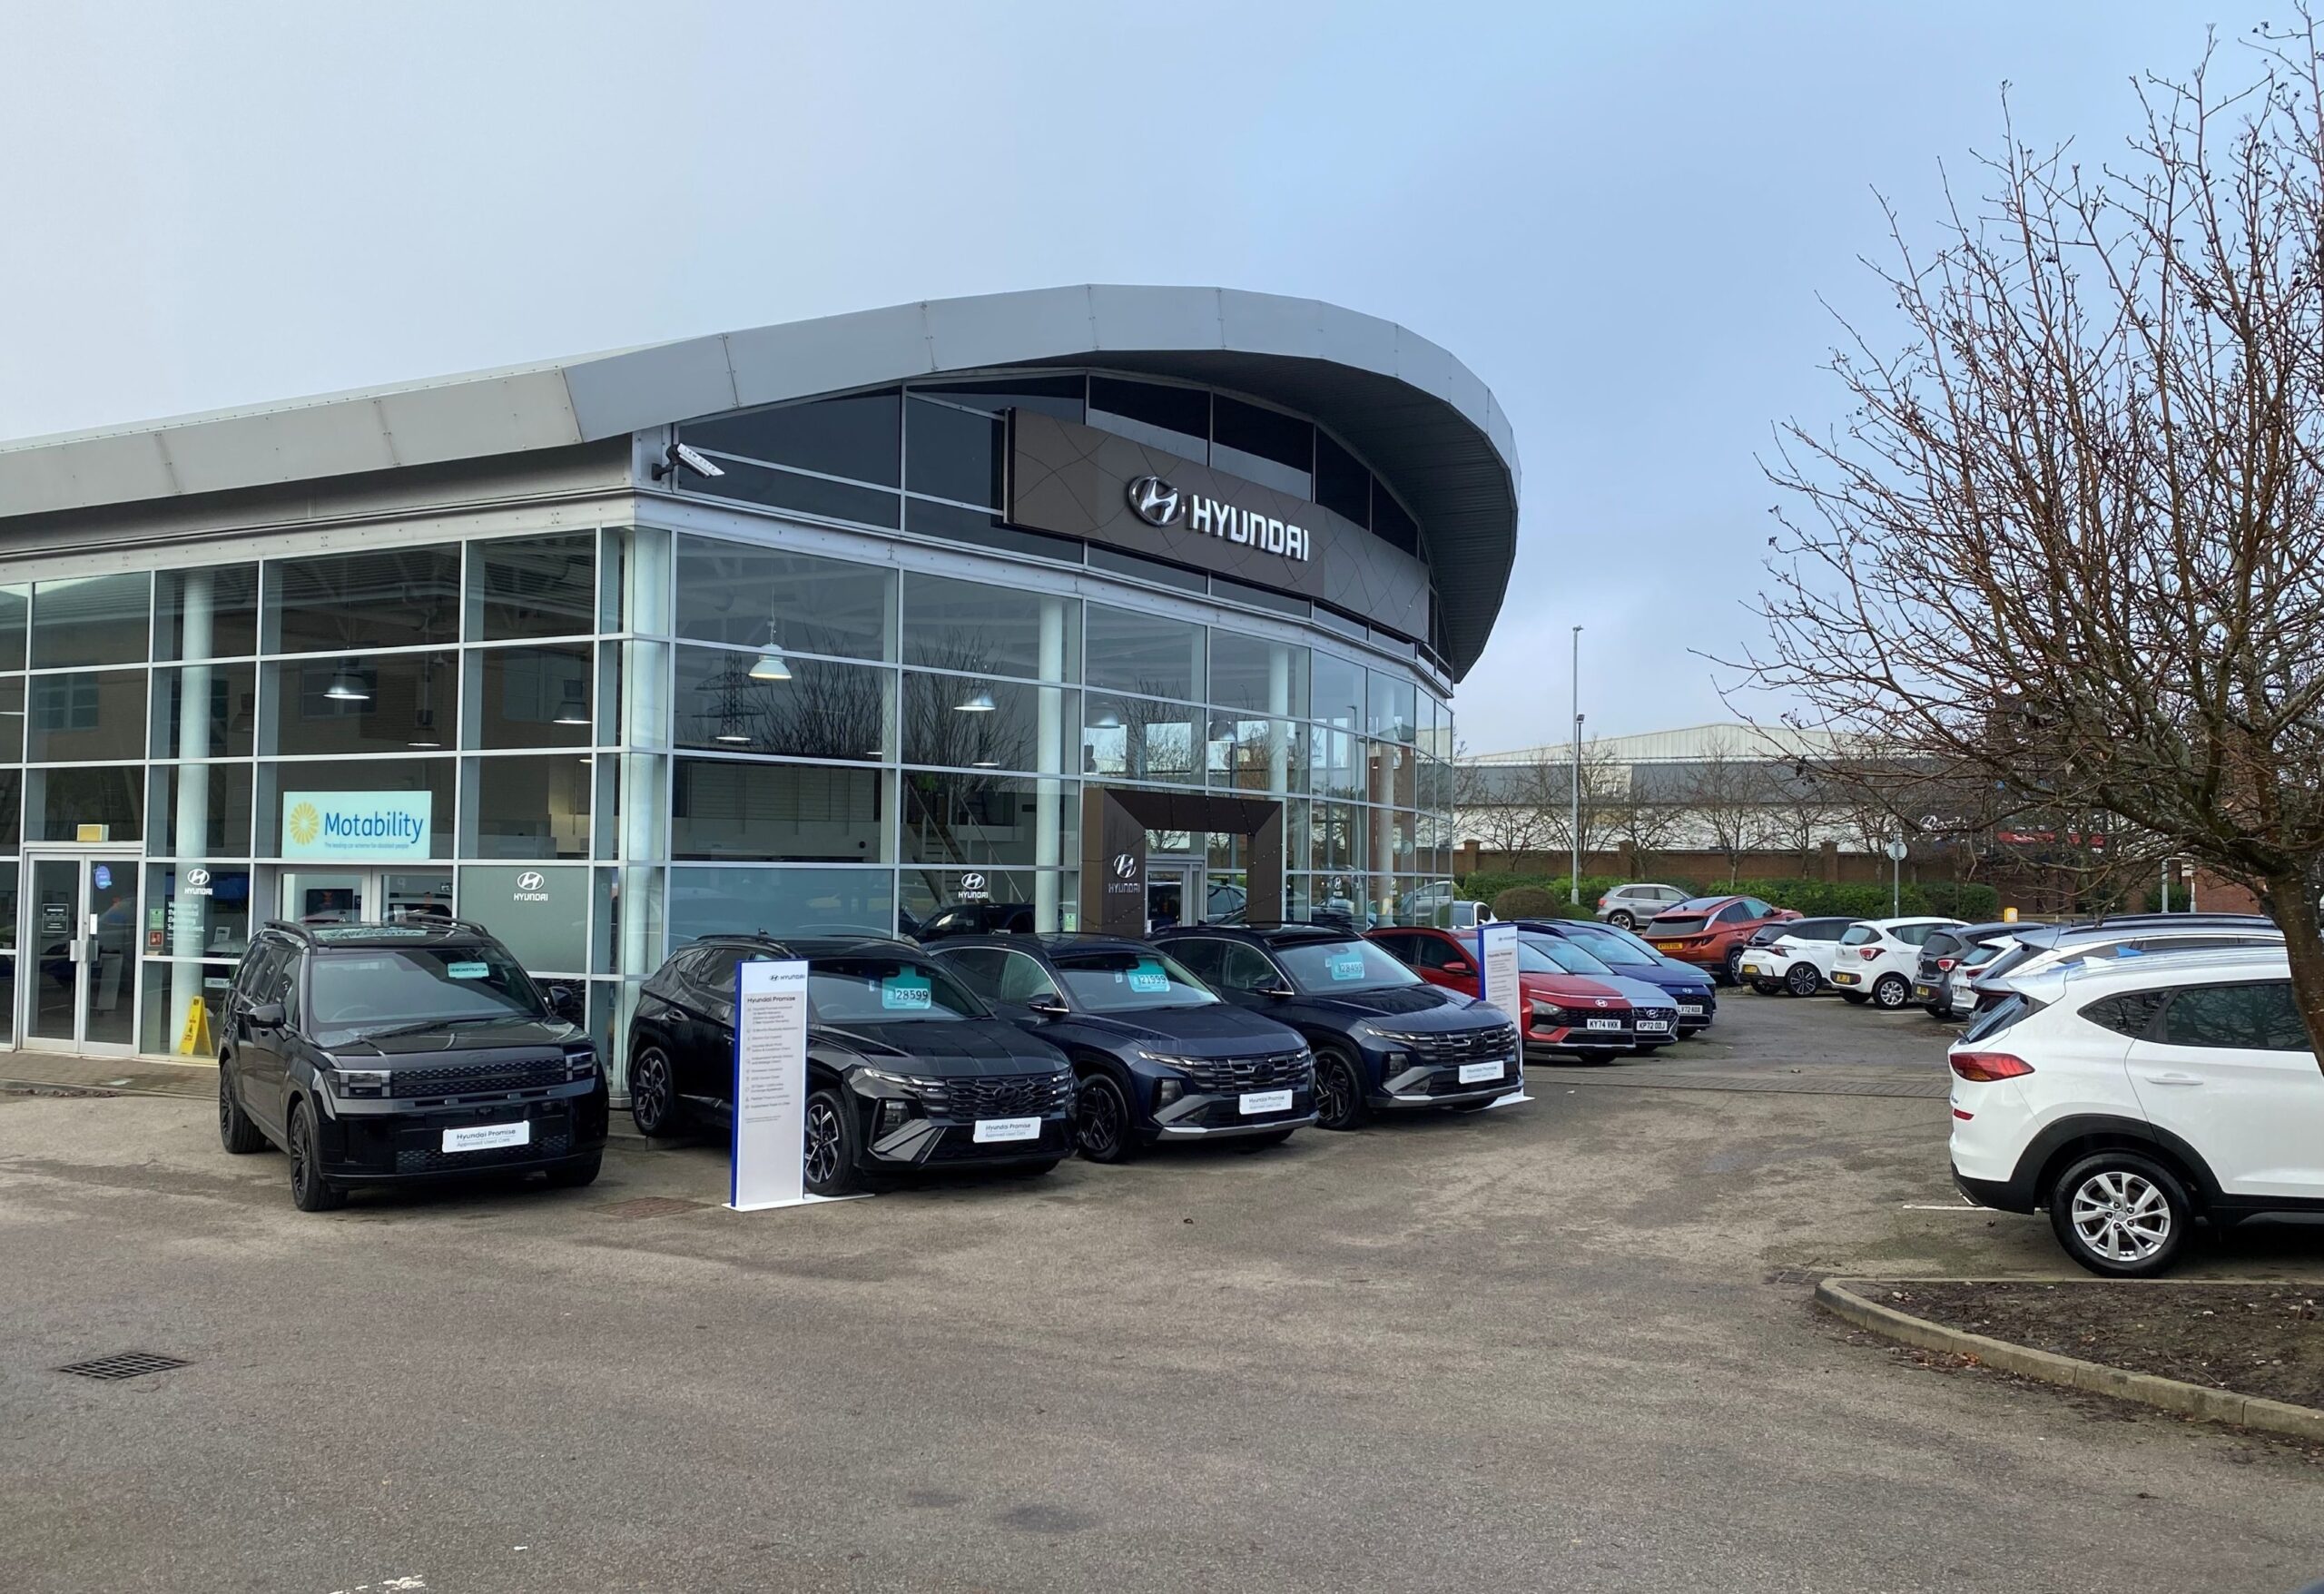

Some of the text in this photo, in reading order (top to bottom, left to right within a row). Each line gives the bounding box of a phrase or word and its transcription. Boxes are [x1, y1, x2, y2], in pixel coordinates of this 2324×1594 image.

[1191, 495, 1309, 562] HYUNDAI
[324, 811, 424, 844] Motability
[184, 888, 213, 896] HYUNDAI
[1108, 882, 1141, 894] HYUNDAI
[513, 892, 549, 901] HYUNDAI
[958, 890, 989, 899] HYUNDAI
[896, 989, 929, 1000] 28599
[1590, 1019, 1606, 1028] KY74
[457, 1128, 517, 1141] Hyundai Promise
